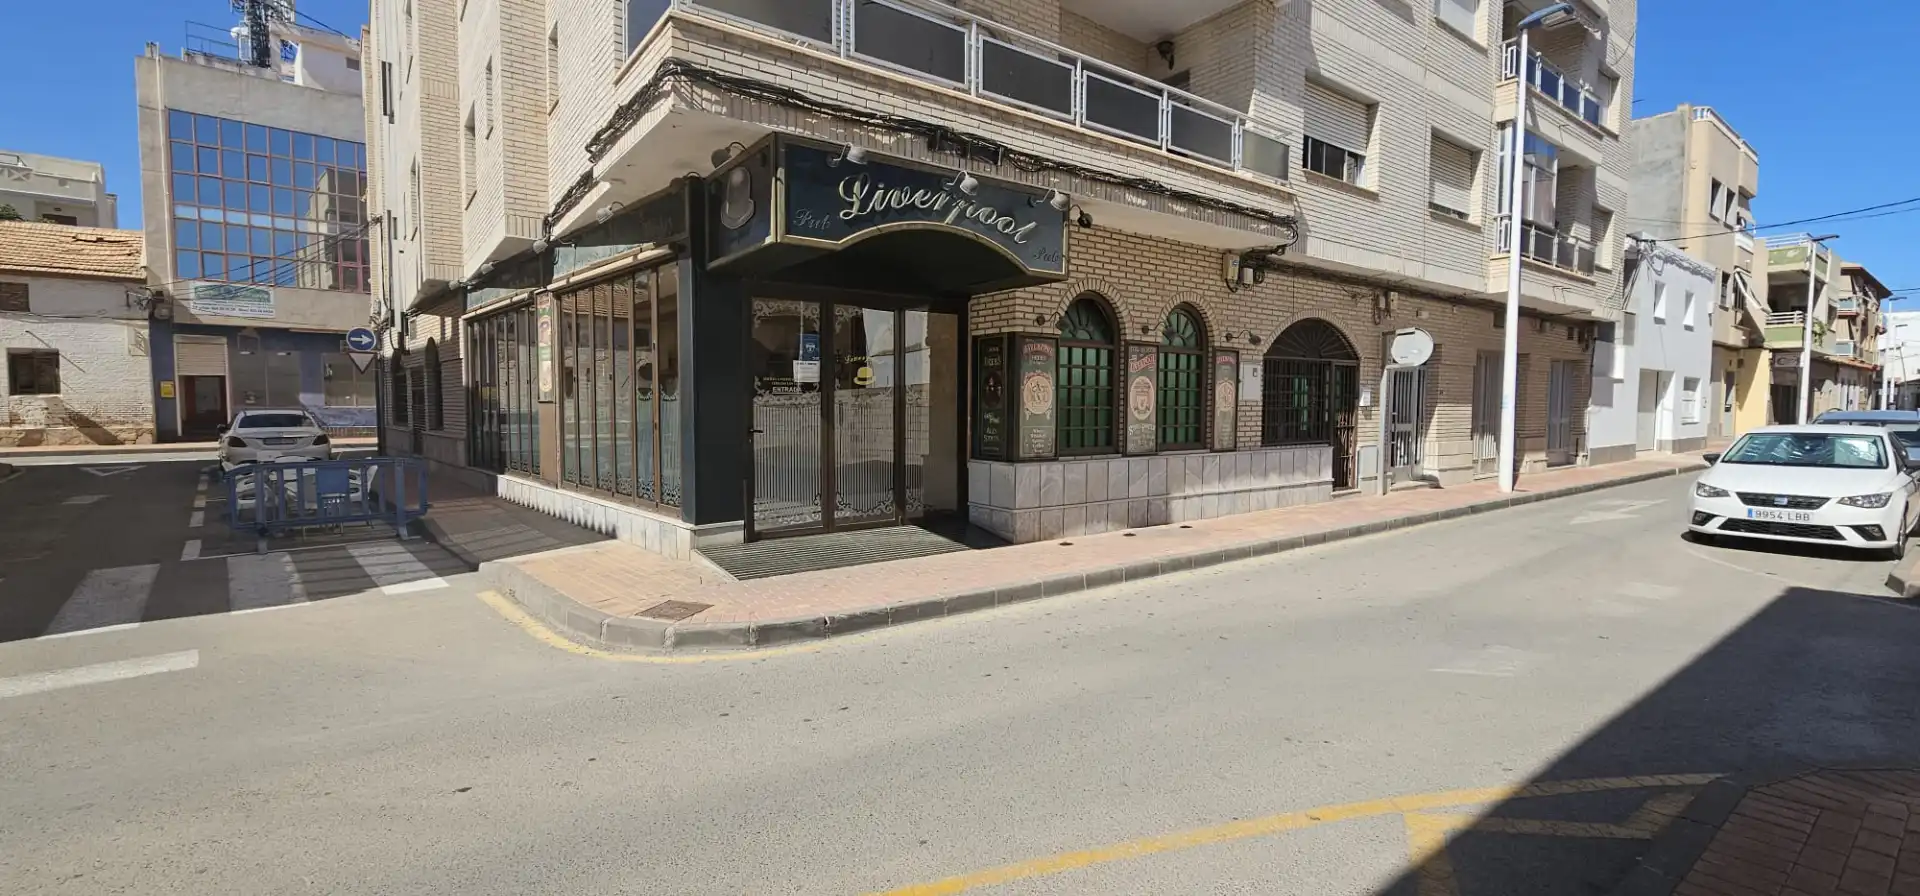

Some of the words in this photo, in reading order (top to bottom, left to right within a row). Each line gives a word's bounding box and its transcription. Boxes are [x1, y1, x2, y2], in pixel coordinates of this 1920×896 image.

[838, 172, 1037, 244] Liverpool
[793, 208, 832, 230] Pub
[1033, 247, 1060, 263] Pub
[1756, 510, 1783, 520] 9954
[1787, 512, 1809, 521] LBB
